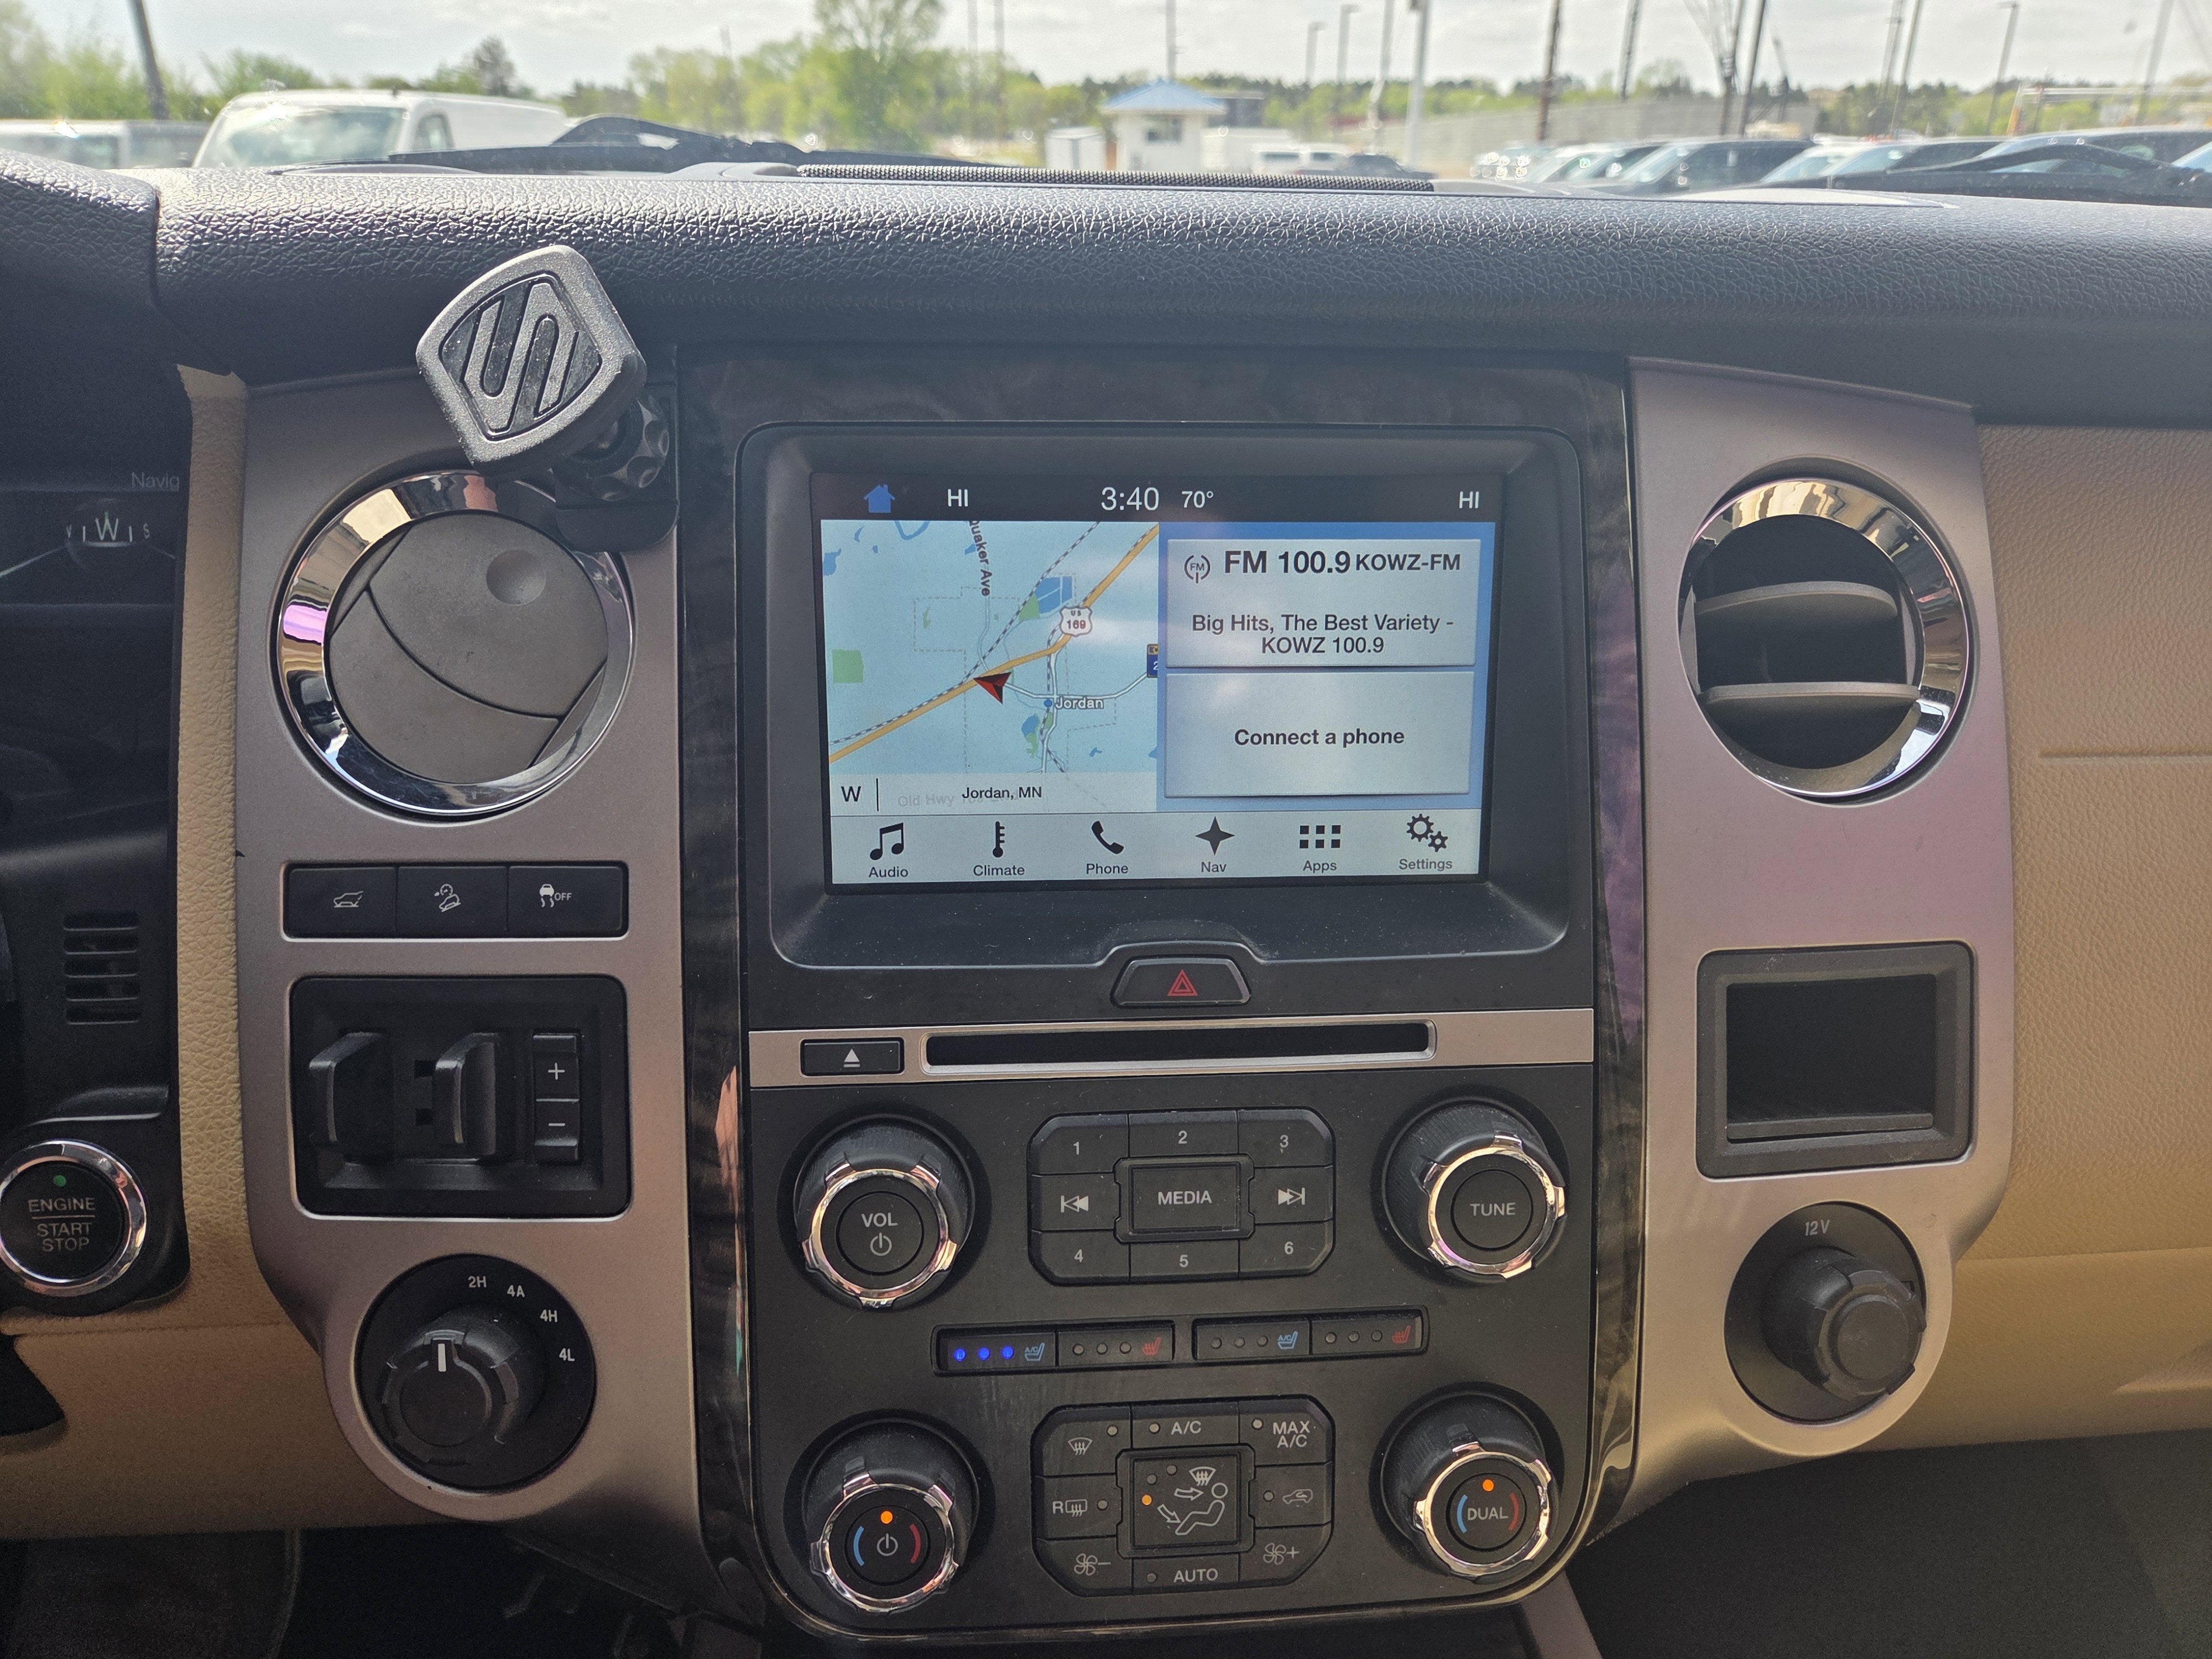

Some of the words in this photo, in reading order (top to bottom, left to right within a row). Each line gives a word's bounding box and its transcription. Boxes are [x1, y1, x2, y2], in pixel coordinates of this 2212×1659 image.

[948, 489, 968, 507] HI
[1102, 487, 1159, 510] 3:40
[1182, 491, 1213, 508] 70°
[1459, 492, 1479, 508] HI
[1225, 551, 1266, 573] FM
[1279, 551, 1350, 573] 100.9
[1357, 554, 1460, 571] KOWZ-FM
[980, 569, 993, 596] Ave
[1067, 619, 1086, 629] 169
[1193, 615, 1223, 634] Big
[1232, 615, 1274, 634] Hits,
[1281, 614, 1317, 630] The
[1325, 614, 1368, 630] Best
[1374, 614, 1440, 634] Variety
[1262, 637, 1325, 653] KOWZ
[1333, 637, 1384, 653] 100.9
[1056, 697, 1104, 710] Jordan
[1235, 729, 1318, 745] Connect
[1326, 733, 1335, 744] a
[1343, 728, 1404, 748] phone
[841, 786, 861, 802] W
[962, 787, 1013, 800] Jordan,
[1019, 787, 1041, 797] MN
[973, 865, 1025, 876] Climate
[1087, 863, 1128, 874] Phone
[1202, 862, 1227, 872] Nav
[1303, 860, 1337, 873] Apps
[1399, 859, 1452, 871] Settings
[869, 867, 908, 877] Audio
[1178, 1130, 1187, 1144] 2
[1280, 1135, 1288, 1147] 3
[1073, 1142, 1079, 1155] 1
[1159, 1191, 1212, 1204] MEDIA
[29, 1197, 95, 1212] ENGINE
[1470, 1203, 1515, 1216] TUNE
[862, 1213, 898, 1227] VOL
[37, 1223, 91, 1237] START
[43, 1238, 90, 1251] STOP
[1285, 1241, 1293, 1254] 6
[1074, 1249, 1083, 1262] 4
[1180, 1255, 1188, 1267] 5
[468, 1276, 486, 1287] 2H
[507, 1285, 525, 1297] 4A
[540, 1310, 557, 1322] 4H
[559, 1348, 575, 1361] 4L
[1171, 1421, 1201, 1434] A/C
[1273, 1421, 1310, 1434] MAX
[1277, 1434, 1307, 1448] A/C
[1053, 1501, 1063, 1514] R
[1468, 1507, 1508, 1520] DUAL
[1174, 1568, 1218, 1582] AUTO
